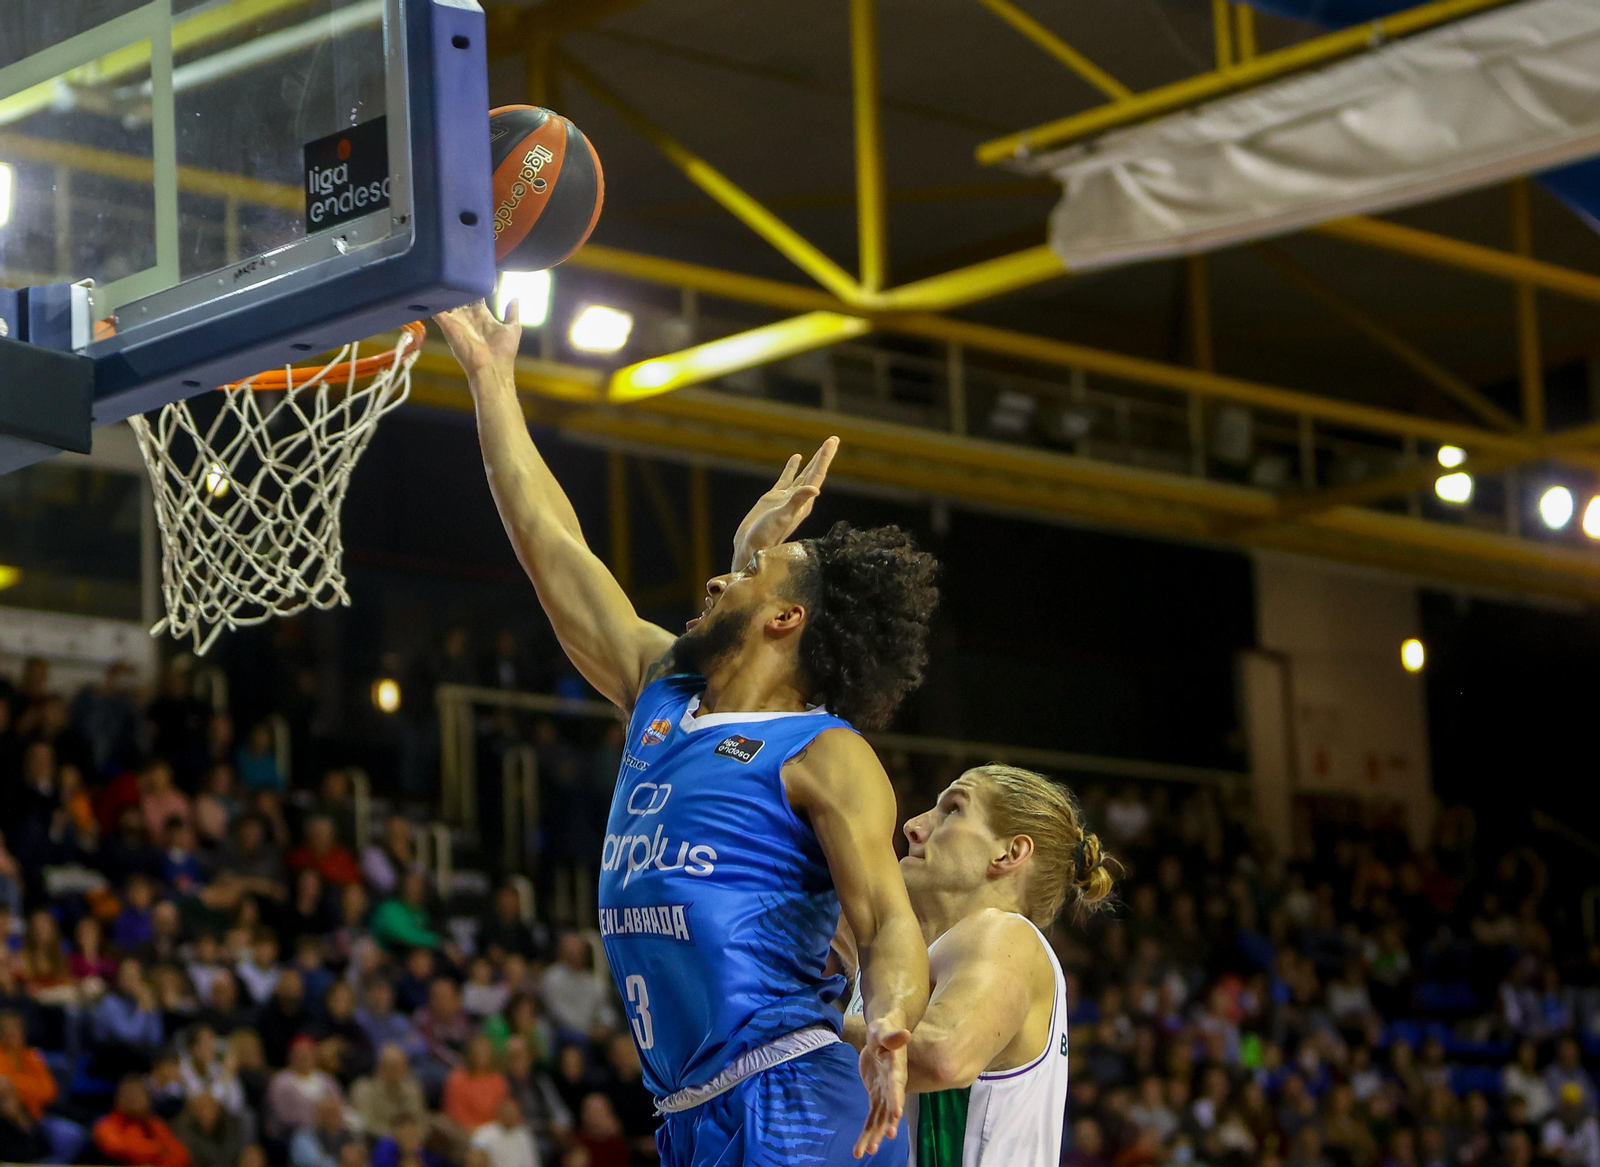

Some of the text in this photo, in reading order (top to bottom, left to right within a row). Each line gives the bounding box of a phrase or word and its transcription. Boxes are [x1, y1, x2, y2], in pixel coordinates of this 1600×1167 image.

[308, 163, 348, 196] liga
[518, 144, 554, 184] liga
[493, 181, 527, 241] ende
[718, 745, 750, 760] endesa
[723, 738, 740, 748] liga
[599, 905, 690, 940] ENLABRADA
[625, 974, 654, 1050] 3
